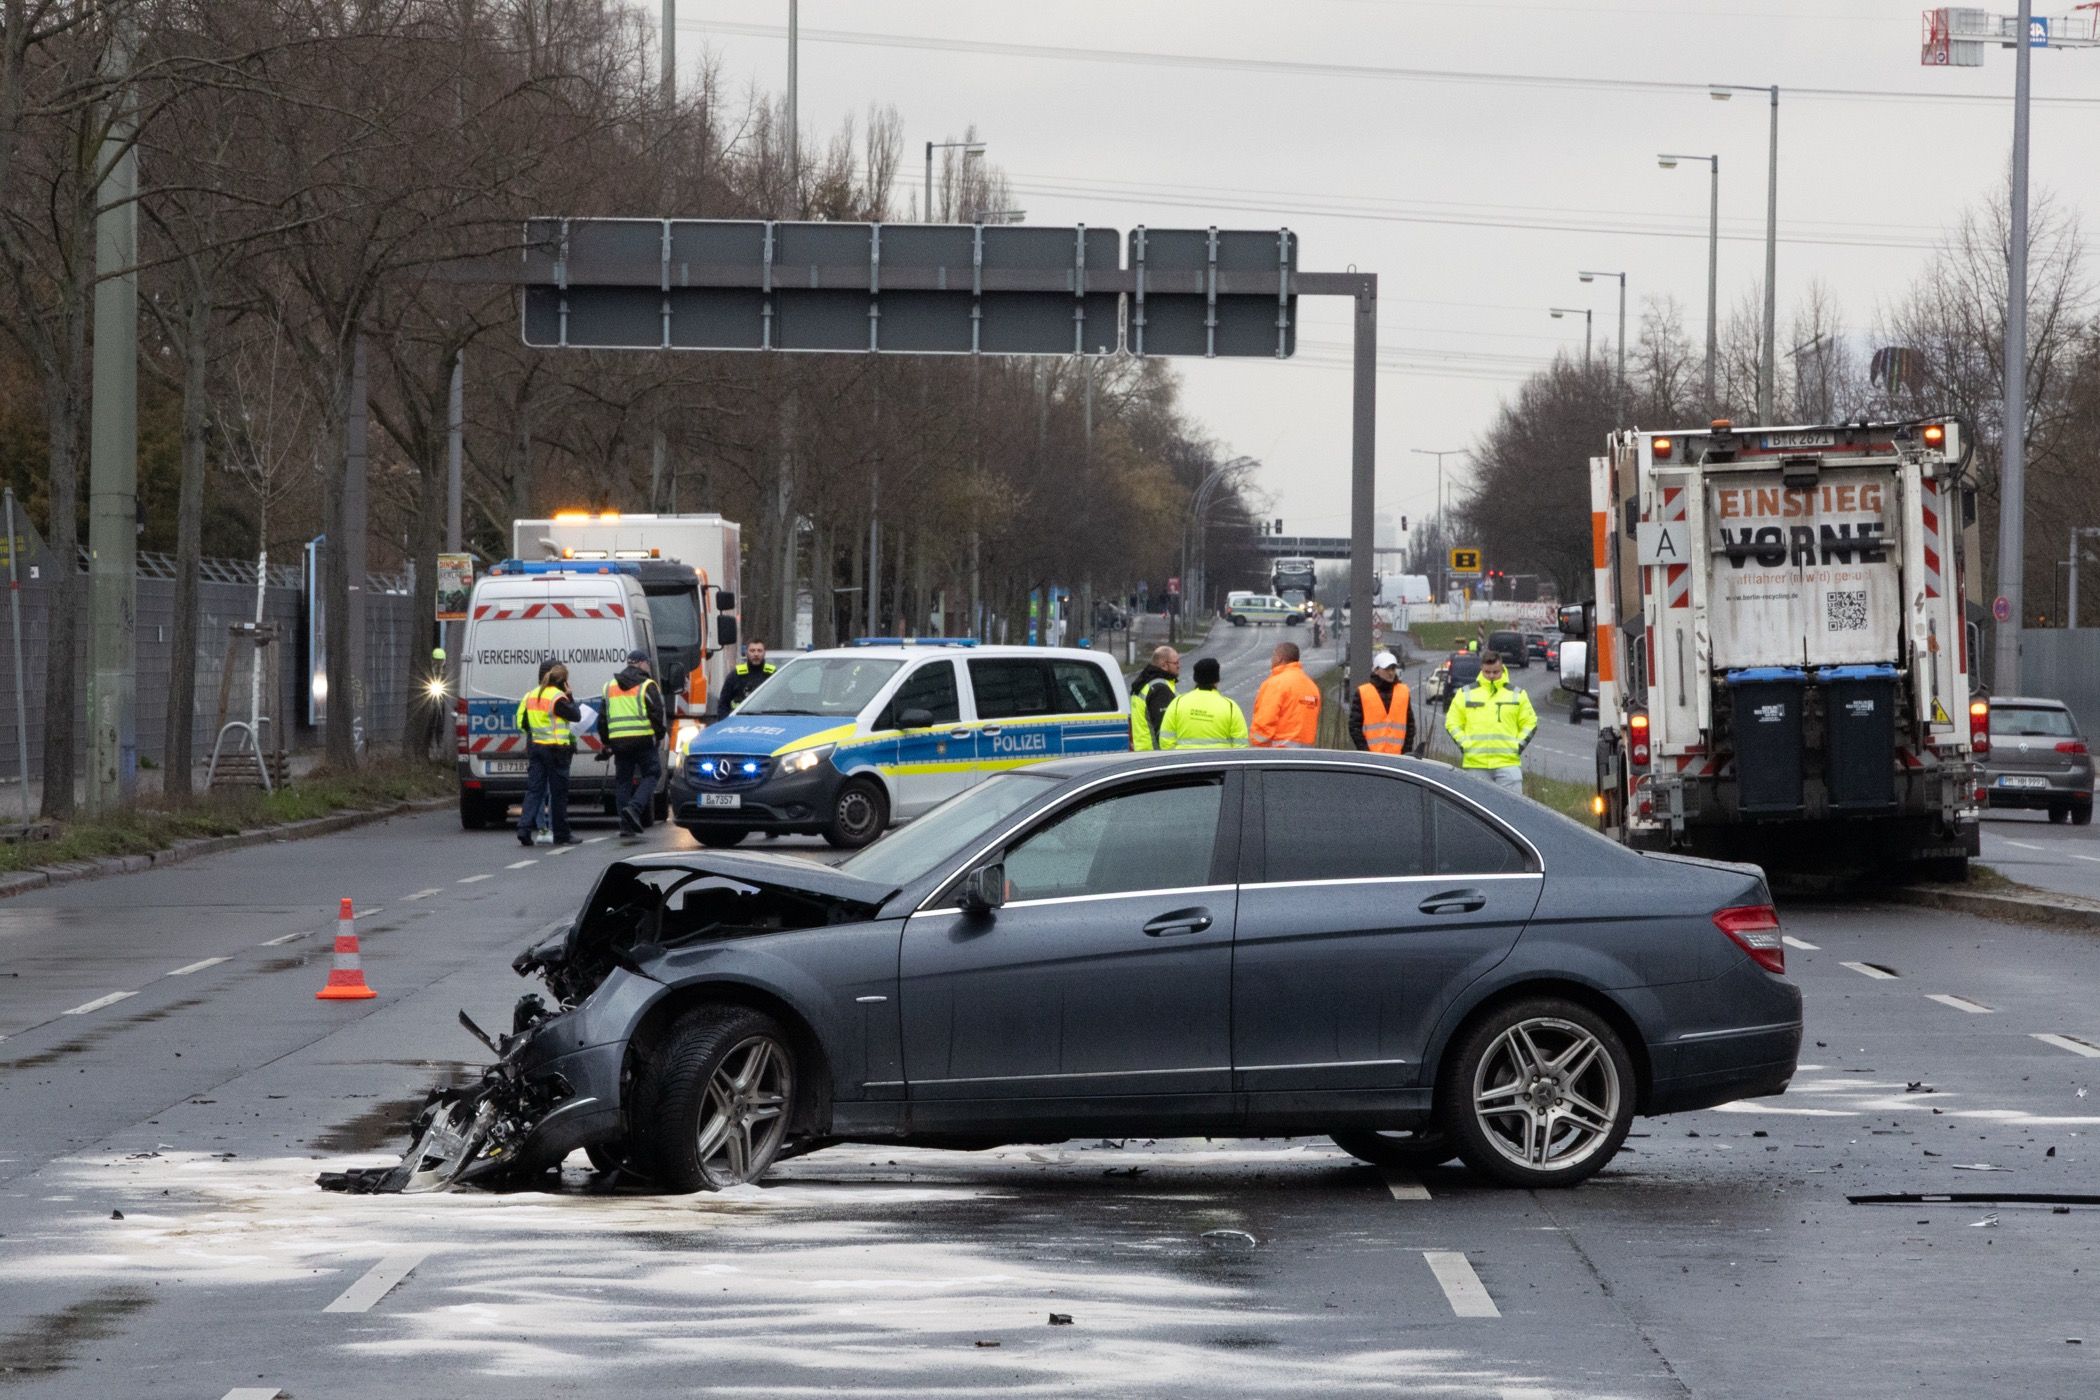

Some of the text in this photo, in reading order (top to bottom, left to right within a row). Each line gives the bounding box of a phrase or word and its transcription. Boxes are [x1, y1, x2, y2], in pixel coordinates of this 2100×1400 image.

[1799, 430, 1830, 445] 2671
[1719, 484, 1882, 519] EINSTIEG
[1656, 528, 1677, 557] A
[1720, 522, 1887, 569] VORNE
[477, 648, 627, 665] VERKEHRSUNFALLKOMMANDO
[471, 714, 516, 731] POLI
[716, 726, 786, 735] POLIZEI
[993, 733, 1046, 752] POLIZEI
[715, 794, 734, 804] 7357
